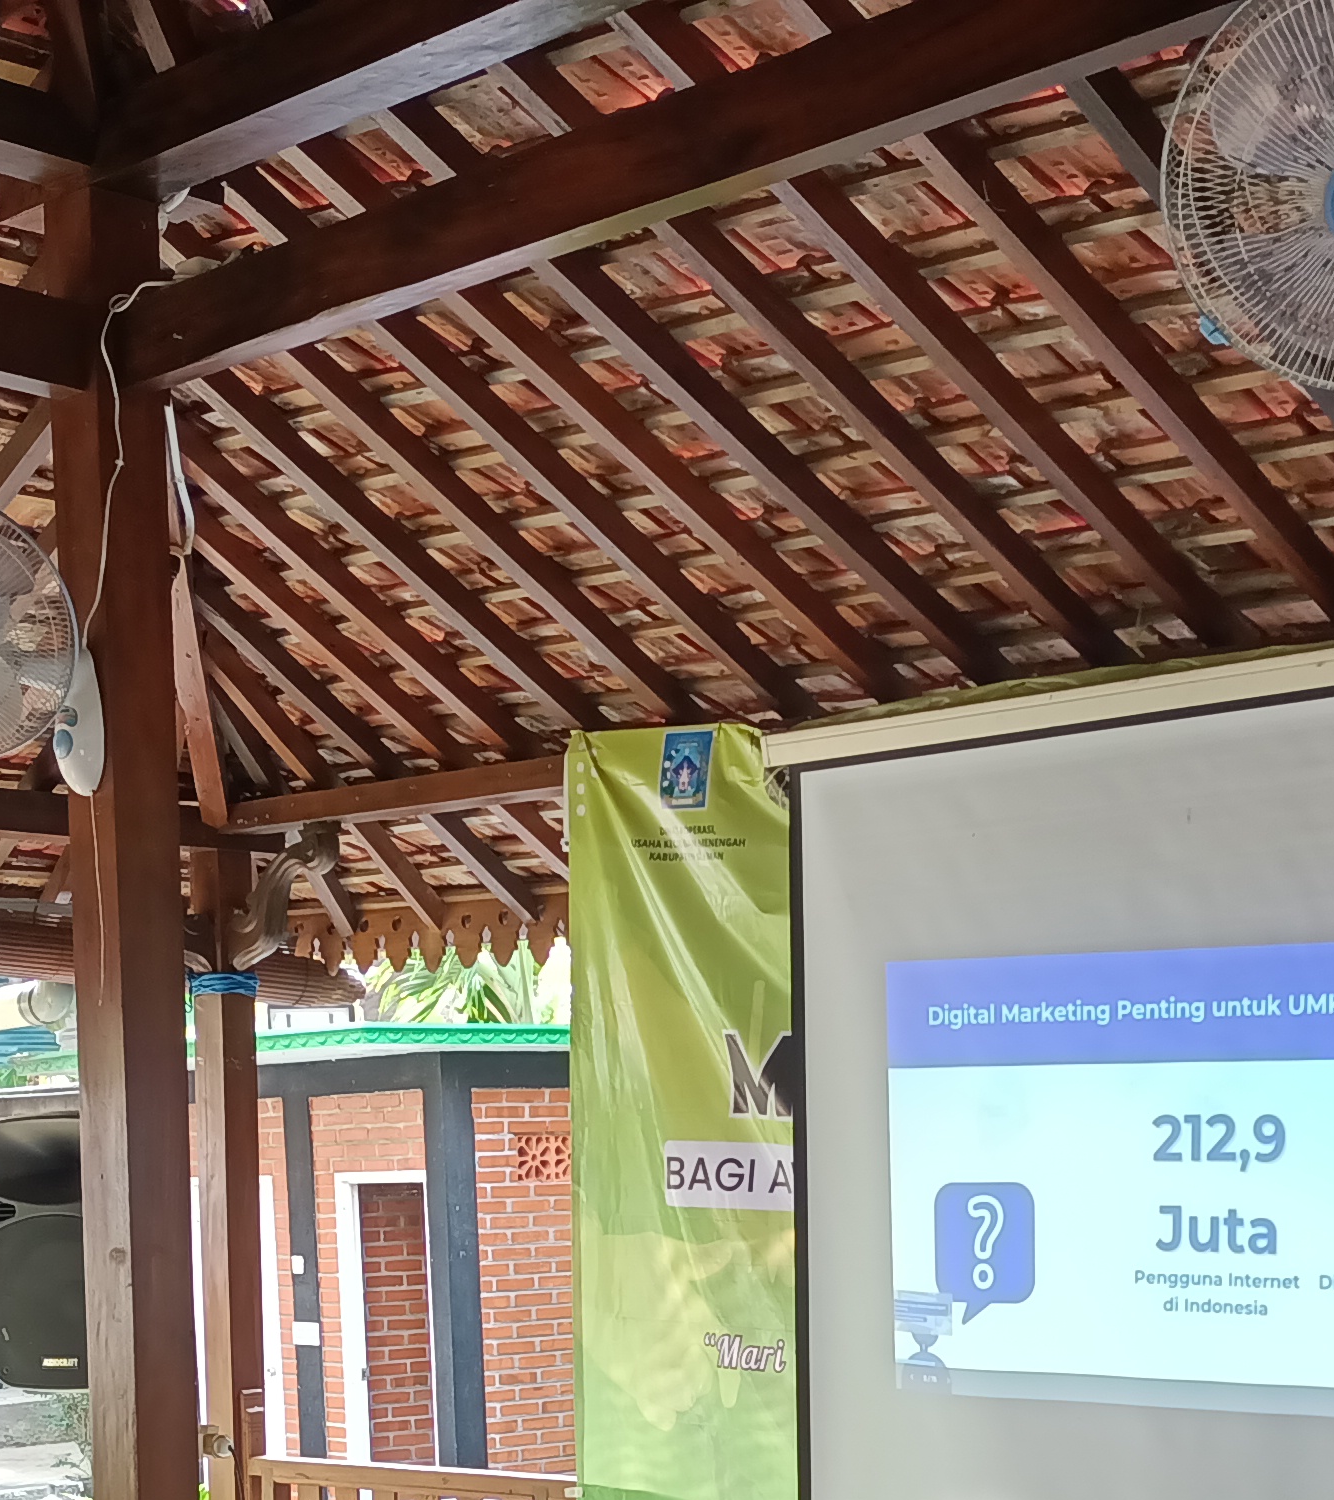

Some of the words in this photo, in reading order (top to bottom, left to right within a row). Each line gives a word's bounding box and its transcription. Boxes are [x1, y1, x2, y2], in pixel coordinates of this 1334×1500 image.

[927, 1002, 995, 1030] Digital
[1001, 999, 1111, 1026] Marketing
[1117, 995, 1206, 1023] Penting
[1212, 993, 1282, 1017] untuk
[1151, 1113, 1286, 1173] 212,9
[666, 1156, 756, 1194] BAGI
[1155, 1205, 1278, 1256] Juta
[1134, 1269, 1223, 1289] Pengguna
[1228, 1272, 1301, 1290] Internet
[1162, 1296, 1180, 1313] di
[1184, 1298, 1269, 1317] Indonesia
